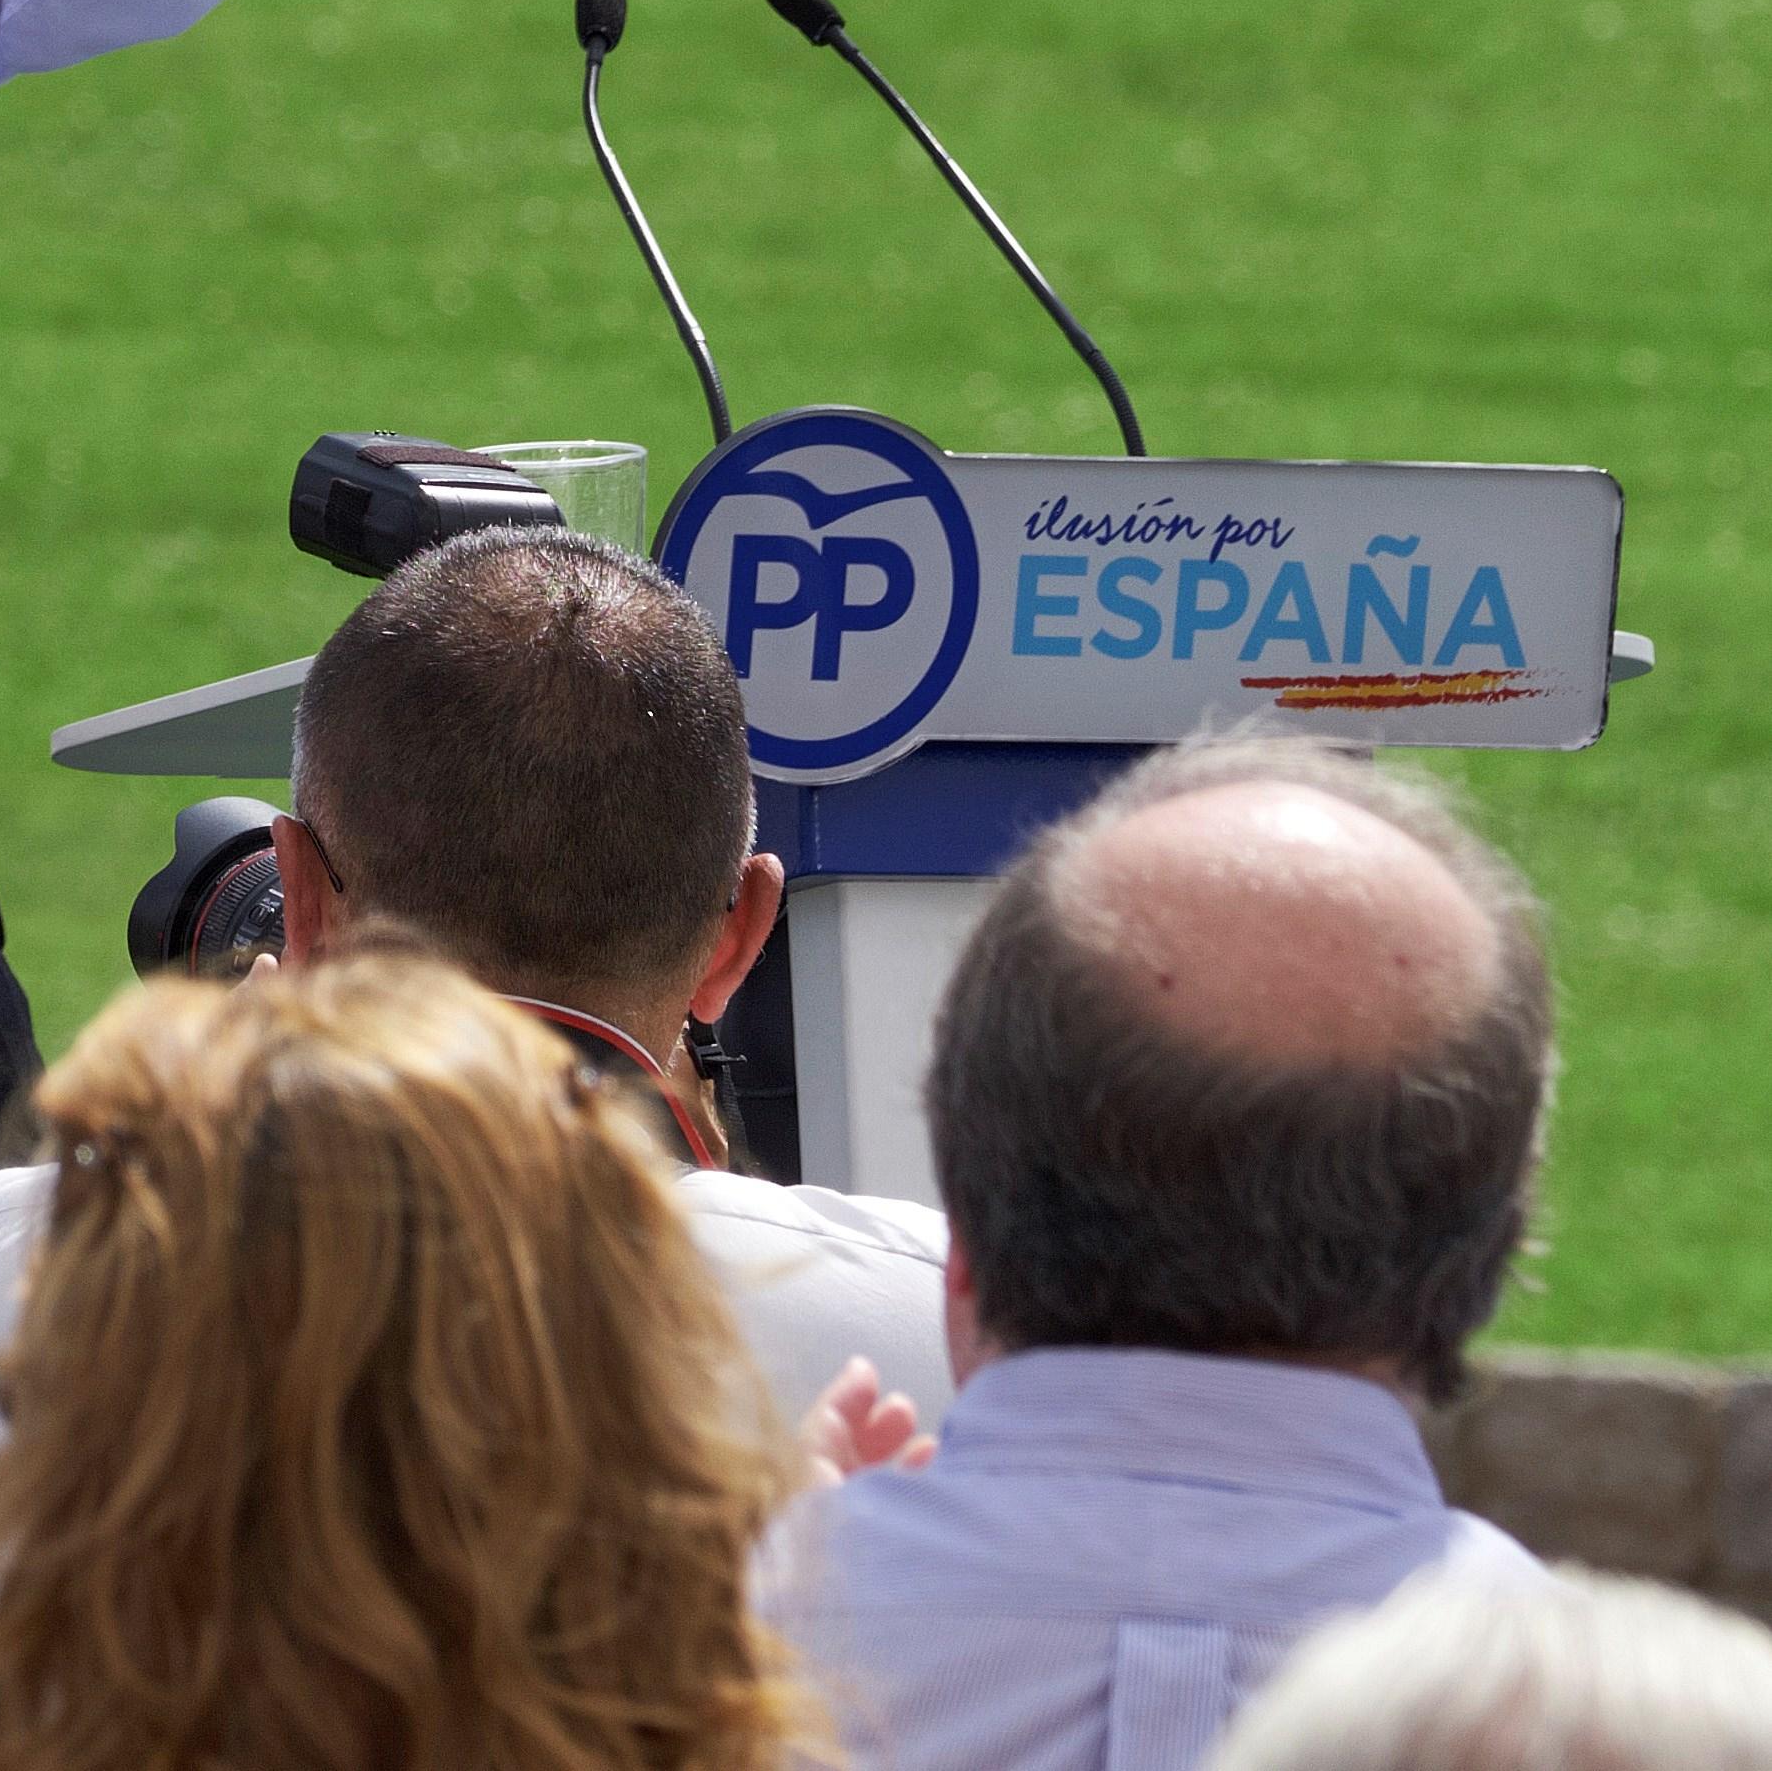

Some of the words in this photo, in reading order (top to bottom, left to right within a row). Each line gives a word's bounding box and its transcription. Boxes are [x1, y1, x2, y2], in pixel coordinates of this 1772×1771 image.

[1023, 495, 1206, 547] ilusión
[1208, 513, 1295, 563] por
[724, 534, 916, 681] PP
[1012, 534, 1527, 668] ESPAÑA
